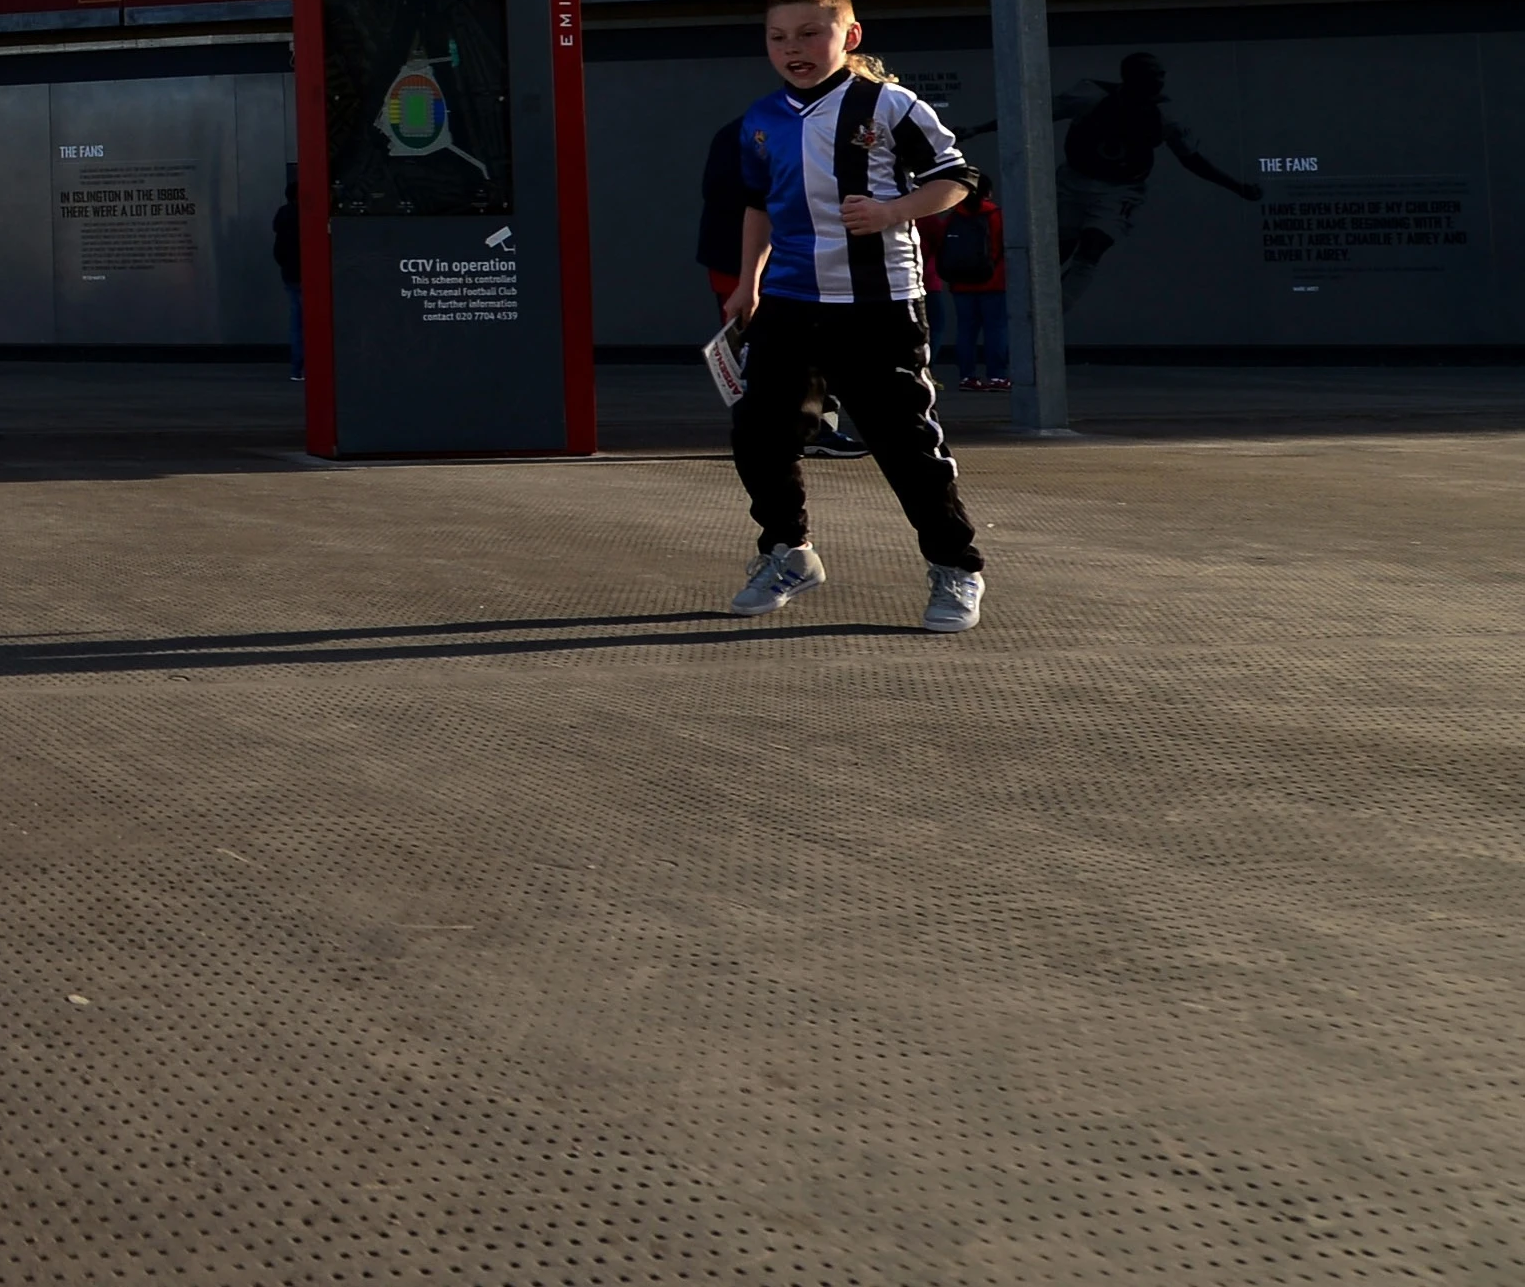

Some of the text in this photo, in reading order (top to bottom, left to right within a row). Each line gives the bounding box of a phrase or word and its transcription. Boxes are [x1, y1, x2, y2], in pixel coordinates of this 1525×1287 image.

[59, 145, 104, 158] THE FANS
[1258, 157, 1318, 172] THE FANS
[60, 191, 70, 203] IN
[72, 190, 122, 203] ISLINGTON
[124, 190, 133, 202] IN
[136, 189, 155, 201] THE
[61, 203, 196, 218] THERE WERE A LOT OF LIAMS
[1269, 203, 1296, 216] HAVE
[1299, 202, 1332, 216] GIVEN
[1335, 202, 1365, 216] EACH
[1368, 201, 1381, 215] OF
[1385, 201, 1402, 214] MY
[1405, 200, 1461, 214] CHILDREN
[1263, 218, 1270, 231] A
[1273, 218, 1314, 231] MIDDLE
[1316, 217, 1347, 231] NAME
[1351, 217, 1411, 230] BEGINNING
[1414, 216, 1443, 229] WITH
[1263, 234, 1294, 247] EMILY
[1297, 234, 1304, 246] T
[1345, 232, 1394, 246] CHARLIE
[1397, 232, 1403, 245] T
[1264, 249, 1303, 262] OLIVER
[1305, 249, 1312, 261] T
[399, 257, 516, 275] CCTV in operation
[411, 274, 517, 284] This scheme is controlled
[401, 286, 518, 299] by the Arsenal Football Club
[424, 299, 518, 309] for further information
[423, 312, 454, 321] contact
[455, 312, 472, 320] 020
